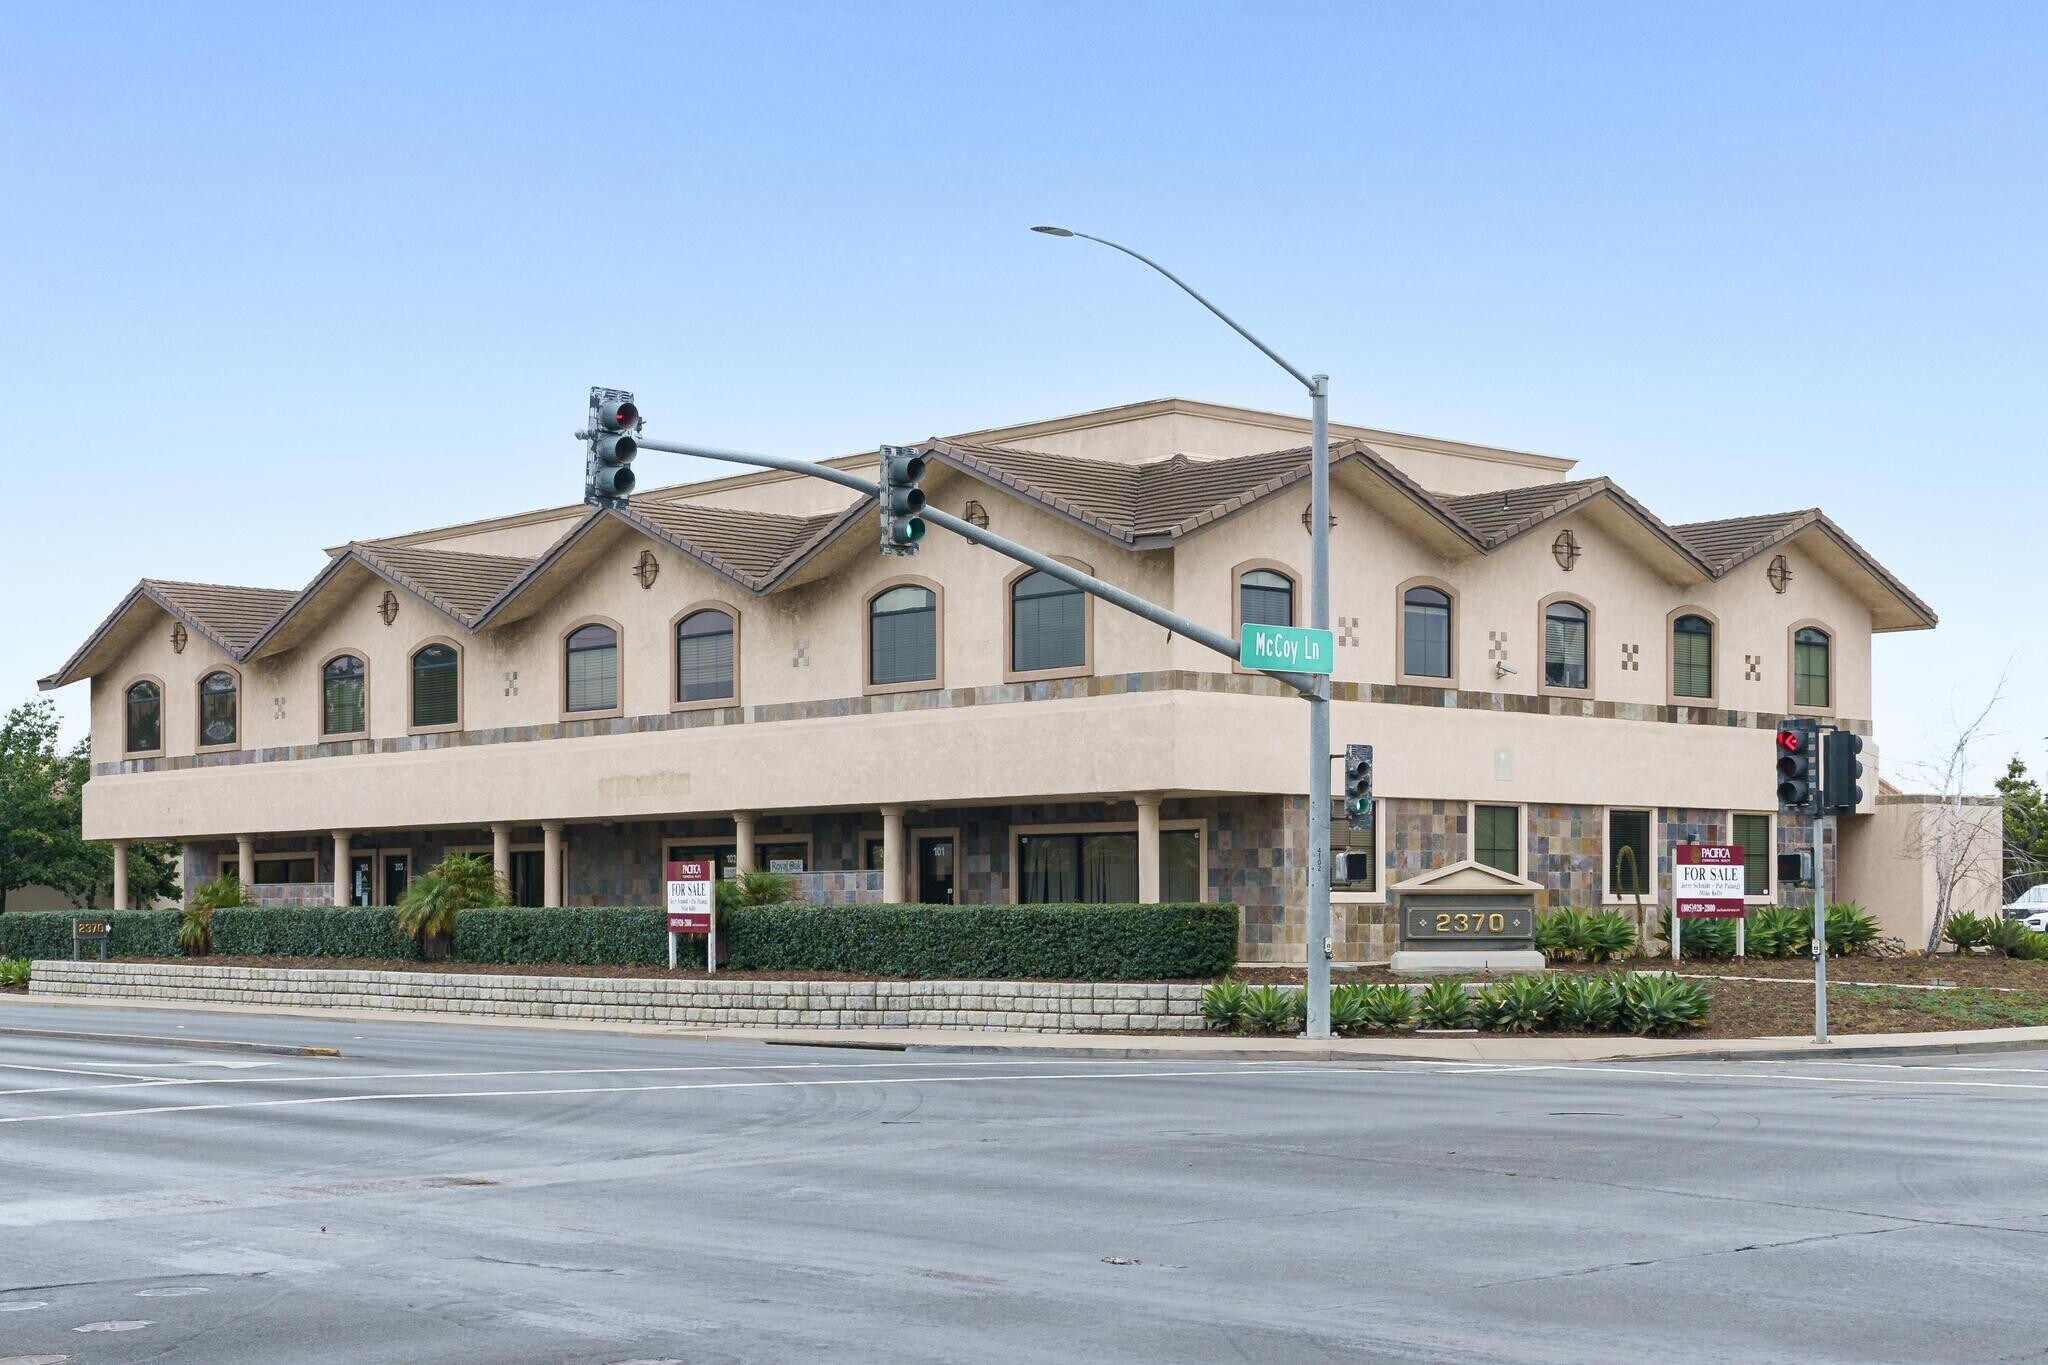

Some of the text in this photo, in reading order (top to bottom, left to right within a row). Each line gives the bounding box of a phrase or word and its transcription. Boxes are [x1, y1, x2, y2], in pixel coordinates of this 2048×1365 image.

[1255, 631, 1320, 665] McCoy Ln
[933, 846, 945, 856] 101
[1701, 847, 1731, 859] PACIFICA
[682, 864, 702, 875] PACIFICA
[771, 861, 802, 872] Royal Oak
[1684, 867, 1738, 881] FOR SALE
[671, 883, 707, 897] FOR SALE
[78, 923, 104, 933] 2370
[1435, 912, 1505, 933] 2370
